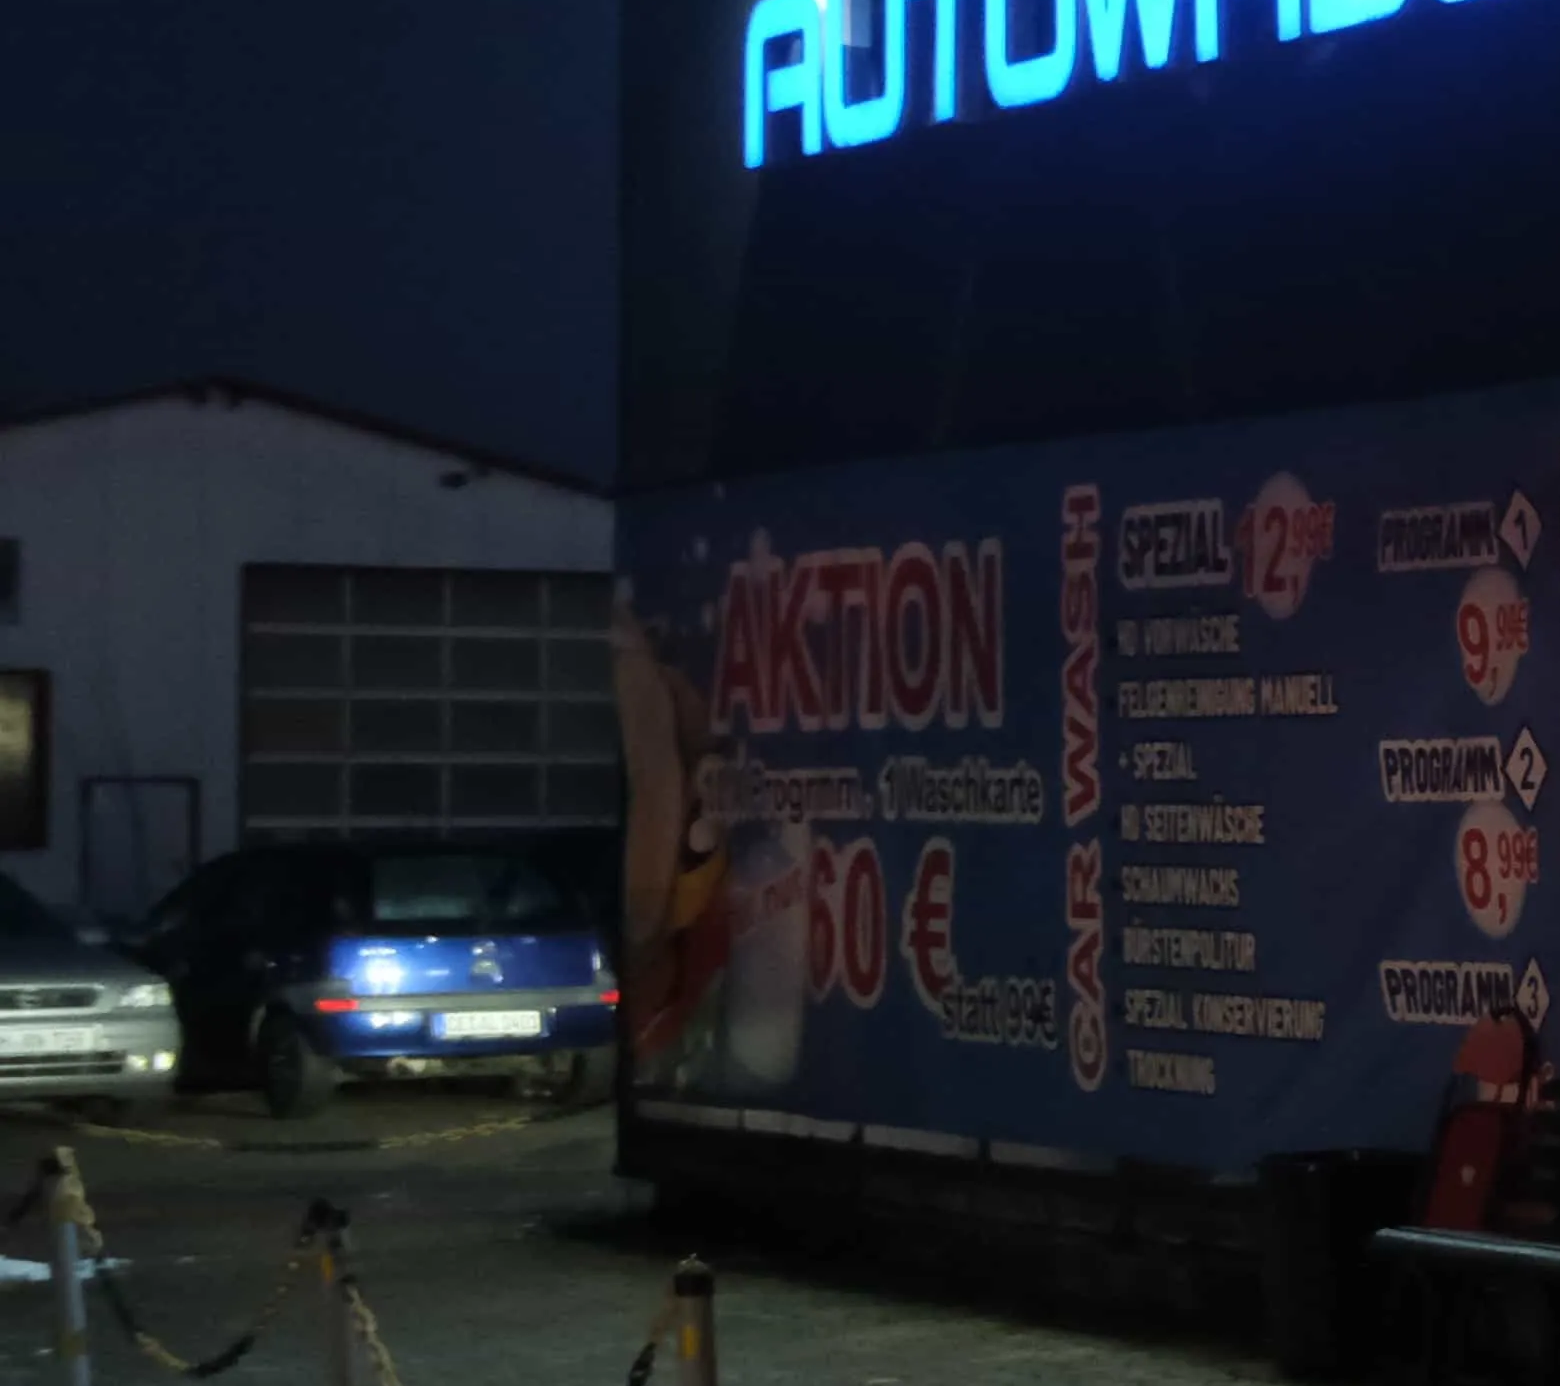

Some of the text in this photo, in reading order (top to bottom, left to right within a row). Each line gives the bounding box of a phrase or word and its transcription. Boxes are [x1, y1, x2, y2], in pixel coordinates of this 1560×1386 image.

[1121, 508, 1229, 581] SPEZIAL
[1514, 508, 1528, 551] 1
[715, 547, 1001, 725] AKTION
[1063, 489, 1104, 1084] CAR WASH
[1132, 740, 1198, 780] SPEZIAL
[1382, 743, 1535, 797] PROGRAMM 2
[1122, 865, 1240, 907] SCHAUMWACHS
[1124, 988, 1188, 1030] SPEZIAL
[1384, 966, 1541, 1020] PROGRAMM 3
